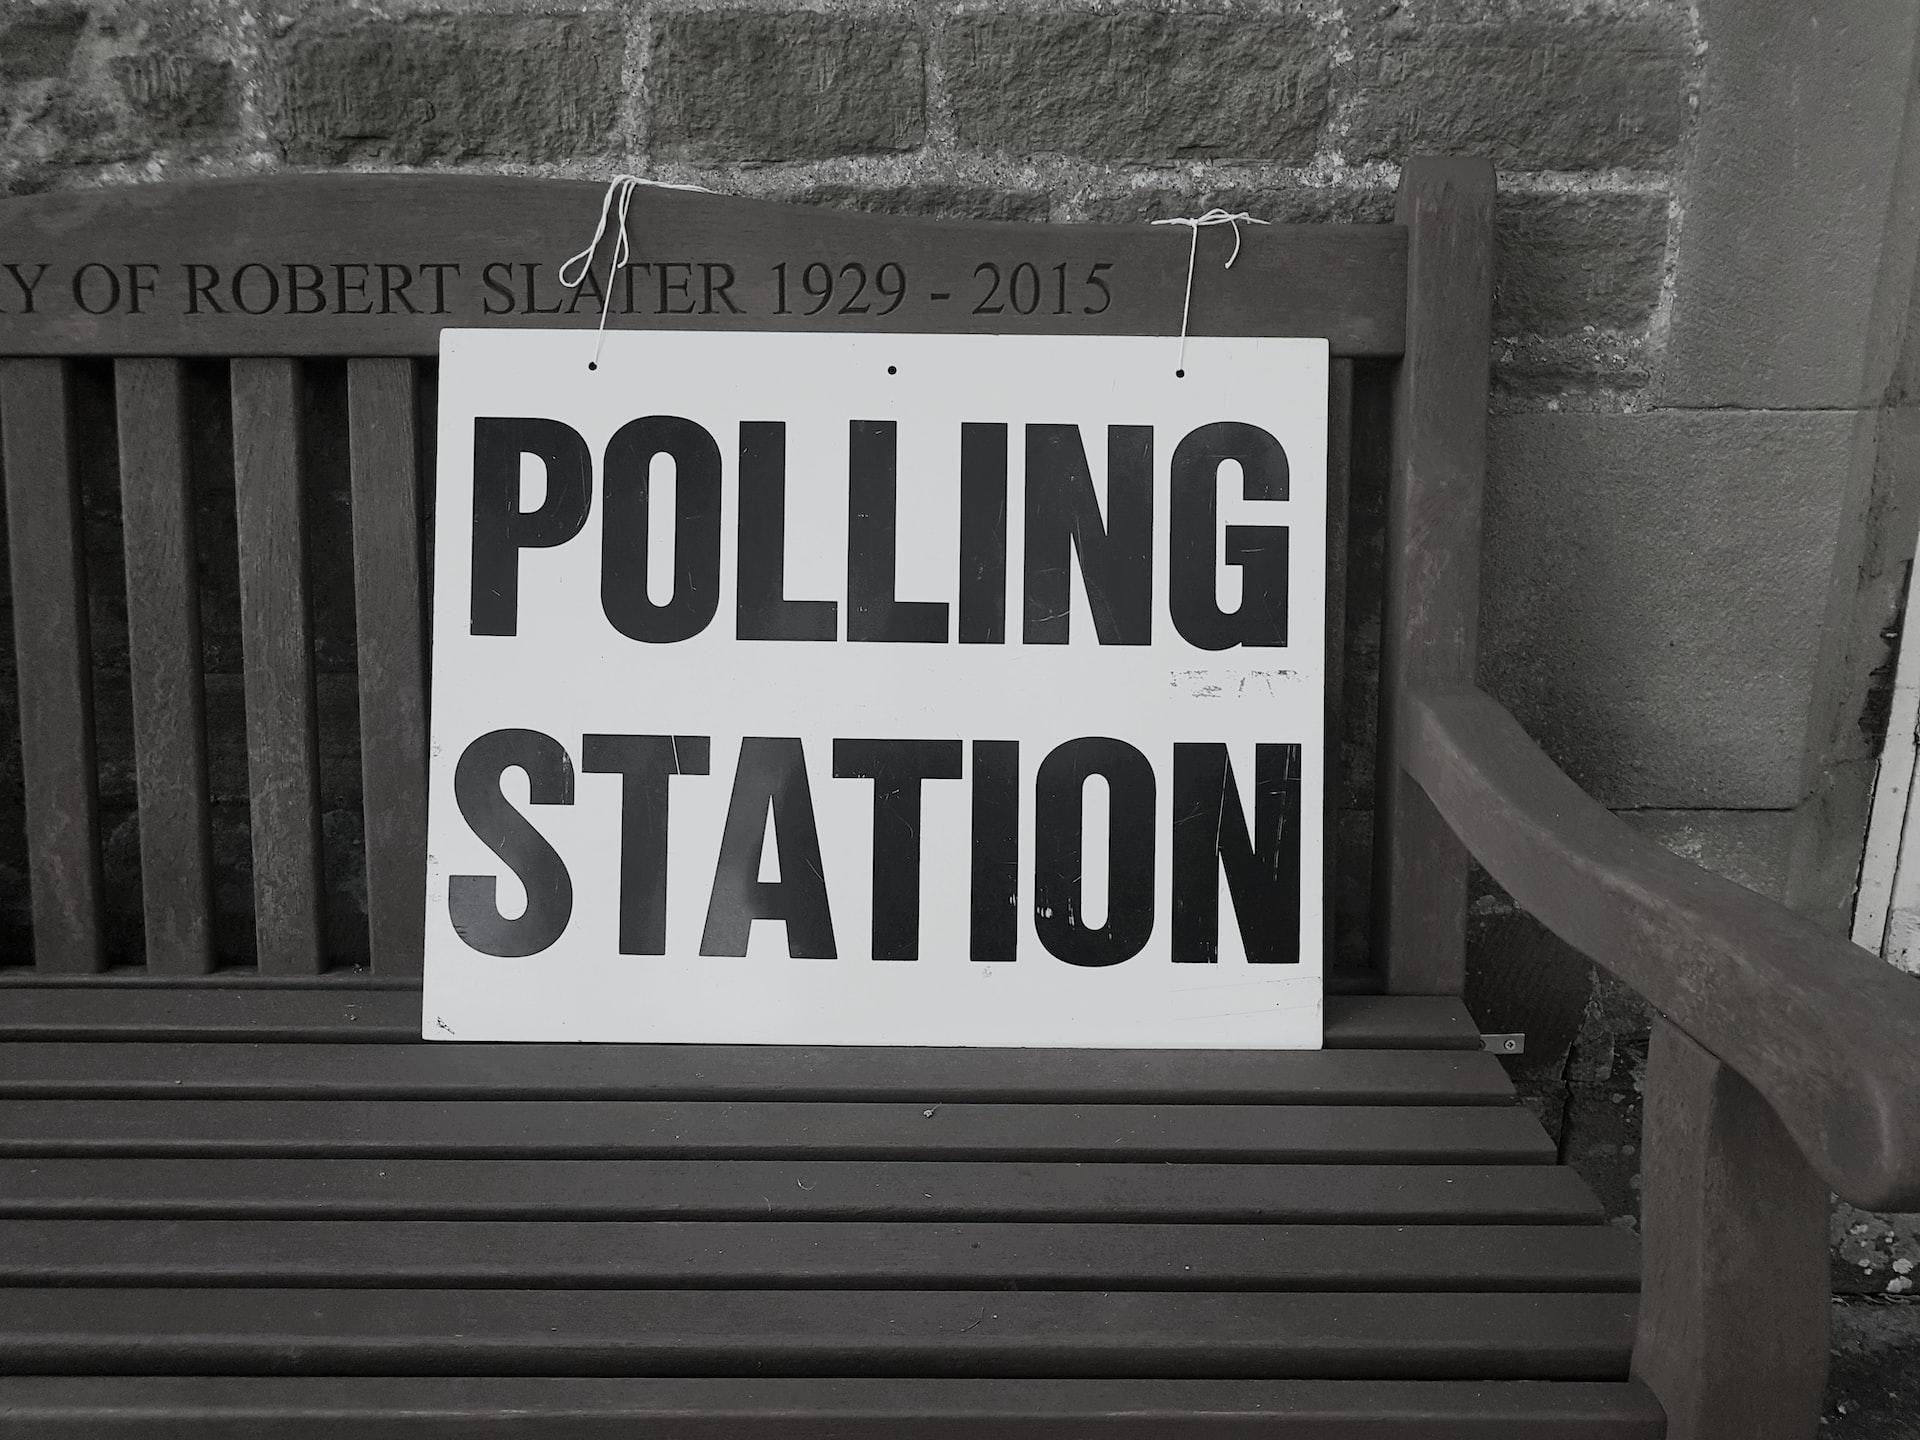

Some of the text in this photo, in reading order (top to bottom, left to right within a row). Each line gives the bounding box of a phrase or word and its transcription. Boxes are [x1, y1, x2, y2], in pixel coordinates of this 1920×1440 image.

[0, 263, 53, 314] Y
[72, 262, 161, 315] OF
[183, 262, 461, 315] ROBERT
[482, 262, 747, 316] SLATER
[771, 262, 907, 316] 1929
[973, 263, 1114, 316] 2015
[471, 415, 1290, 651] POLLING
[449, 729, 1302, 967] STATION
